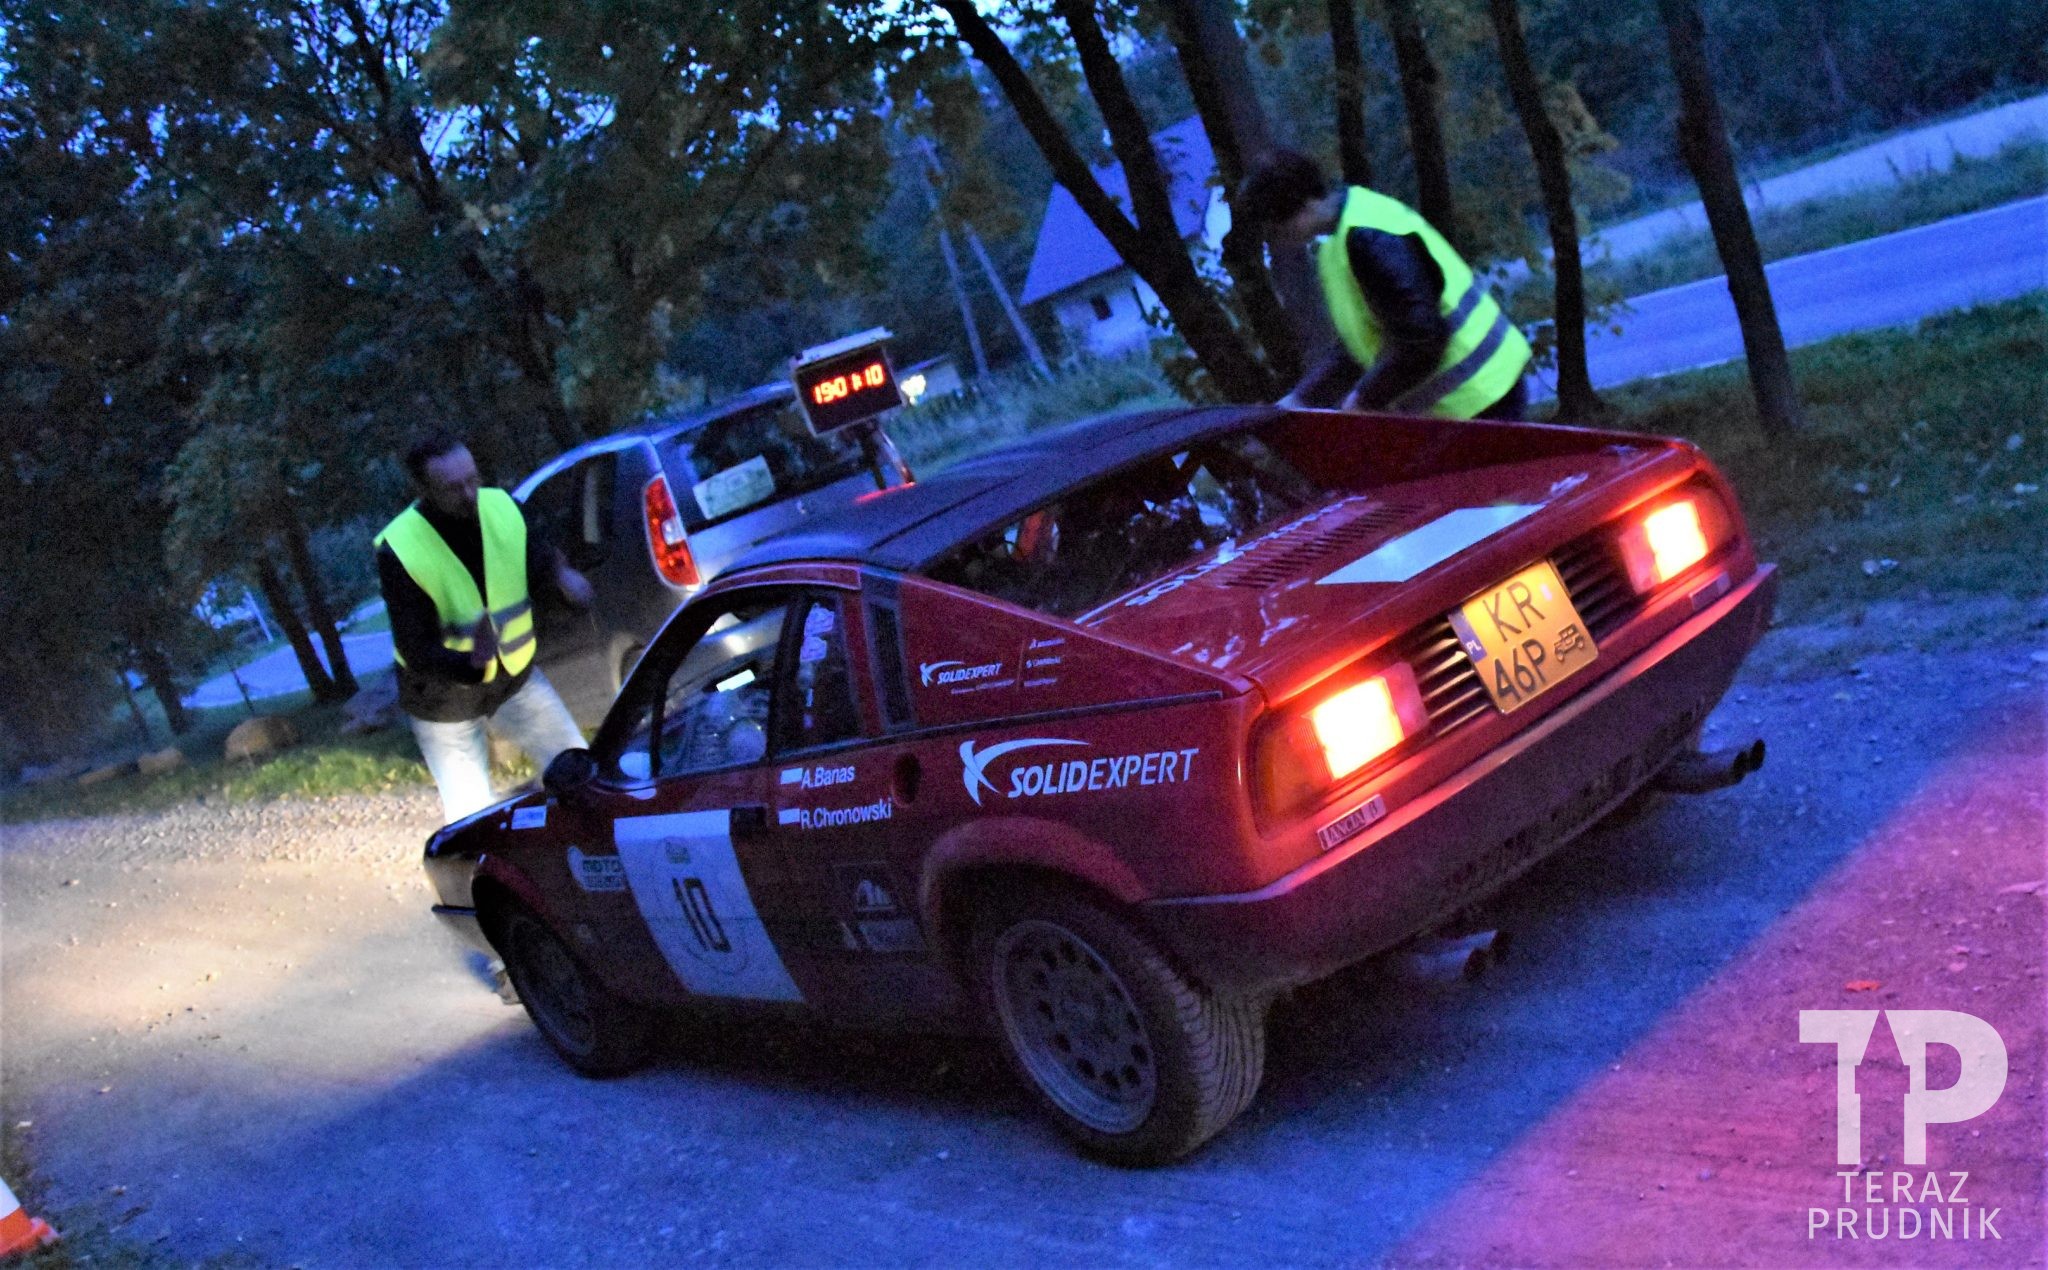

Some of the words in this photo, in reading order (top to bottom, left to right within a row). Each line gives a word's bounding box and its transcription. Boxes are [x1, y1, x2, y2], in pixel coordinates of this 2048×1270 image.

[1482, 581, 1546, 642] KR
[1466, 640, 1482, 655] PL
[937, 662, 1003, 685] SOLIDEXPERT
[1494, 638, 1547, 701] A6P
[801, 766, 855, 789] A.Banas
[1008, 748, 1200, 799] SOLIDEXPERT
[801, 796, 892, 830] R.Chronowski
[672, 877, 732, 953] 10
